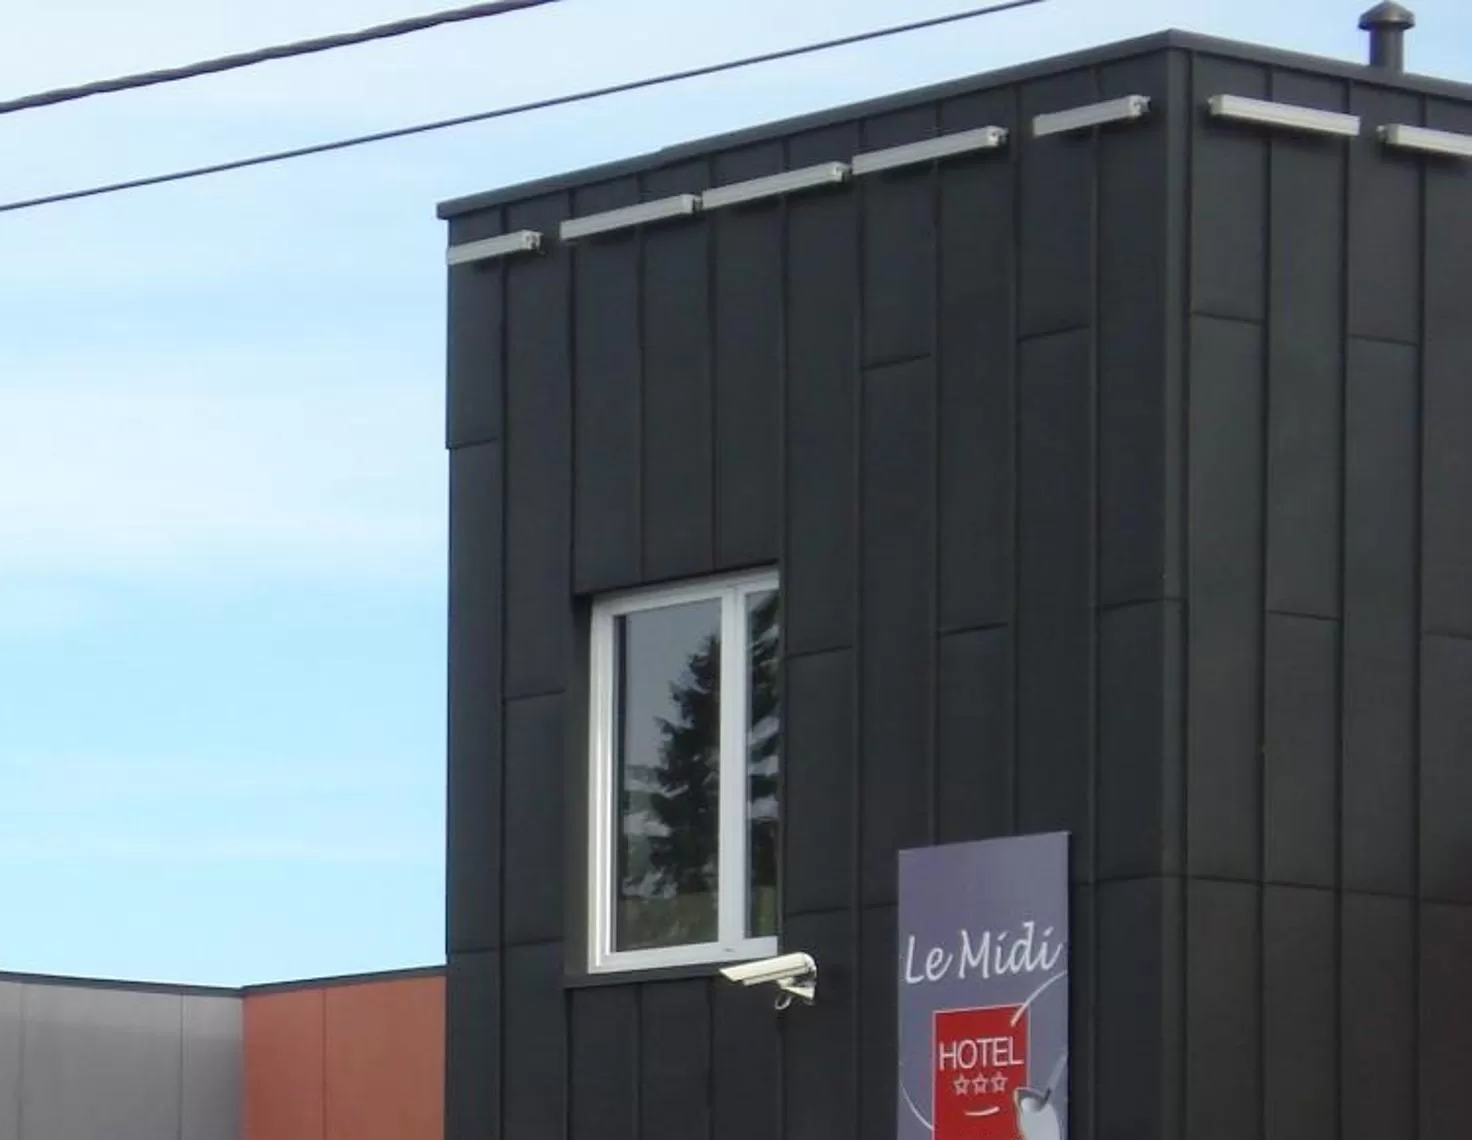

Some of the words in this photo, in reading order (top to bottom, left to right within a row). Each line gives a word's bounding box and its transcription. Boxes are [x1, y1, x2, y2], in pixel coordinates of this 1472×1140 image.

[905, 935, 953, 984] Le
[958, 921, 1064, 979] Midi
[939, 1036, 1024, 1070] HOTEL
